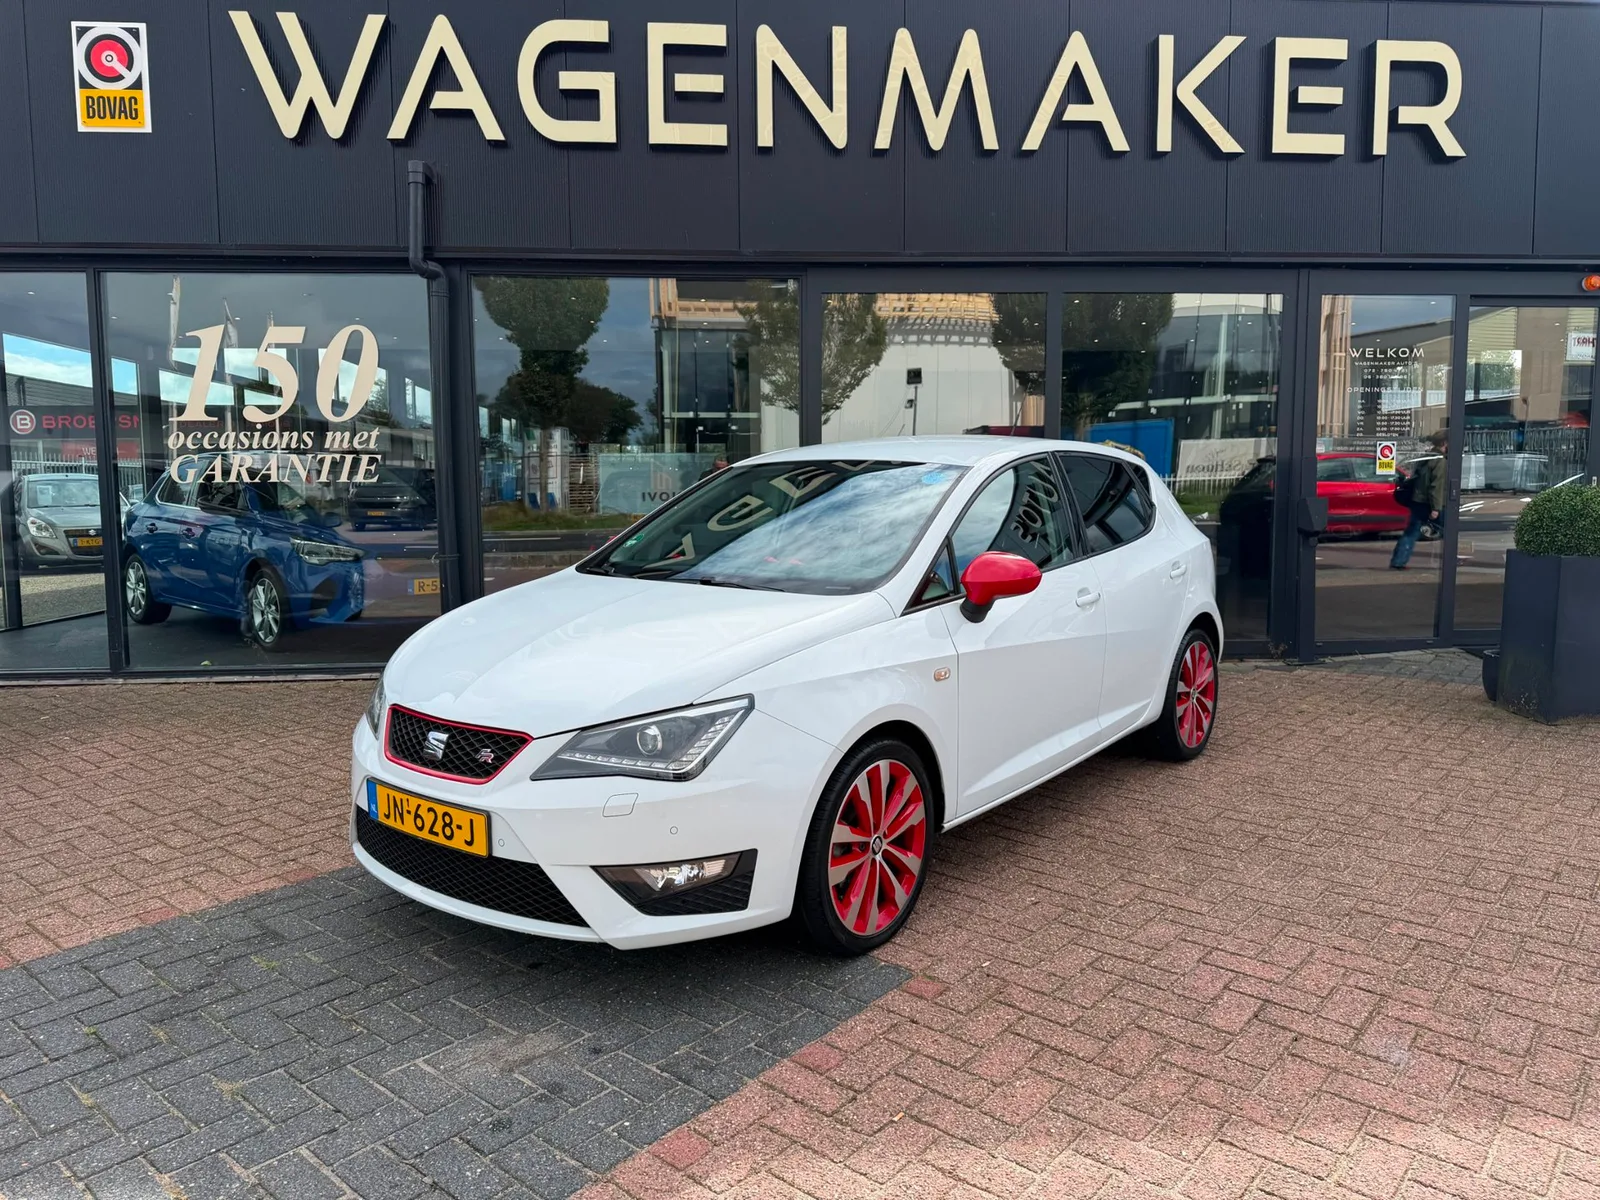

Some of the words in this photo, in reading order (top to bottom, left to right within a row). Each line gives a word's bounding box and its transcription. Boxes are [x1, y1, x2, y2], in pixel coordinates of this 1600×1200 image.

[228, 10, 1467, 158] WAGENMAKER
[86, 95, 139, 121] BOVAG
[1349, 347, 1425, 358] WELKOM
[168, 323, 380, 423] 150
[167, 423, 314, 450] occasions
[325, 427, 381, 450] met
[169, 454, 382, 484] GARANTIE
[383, 793, 475, 847] JN-628-J
